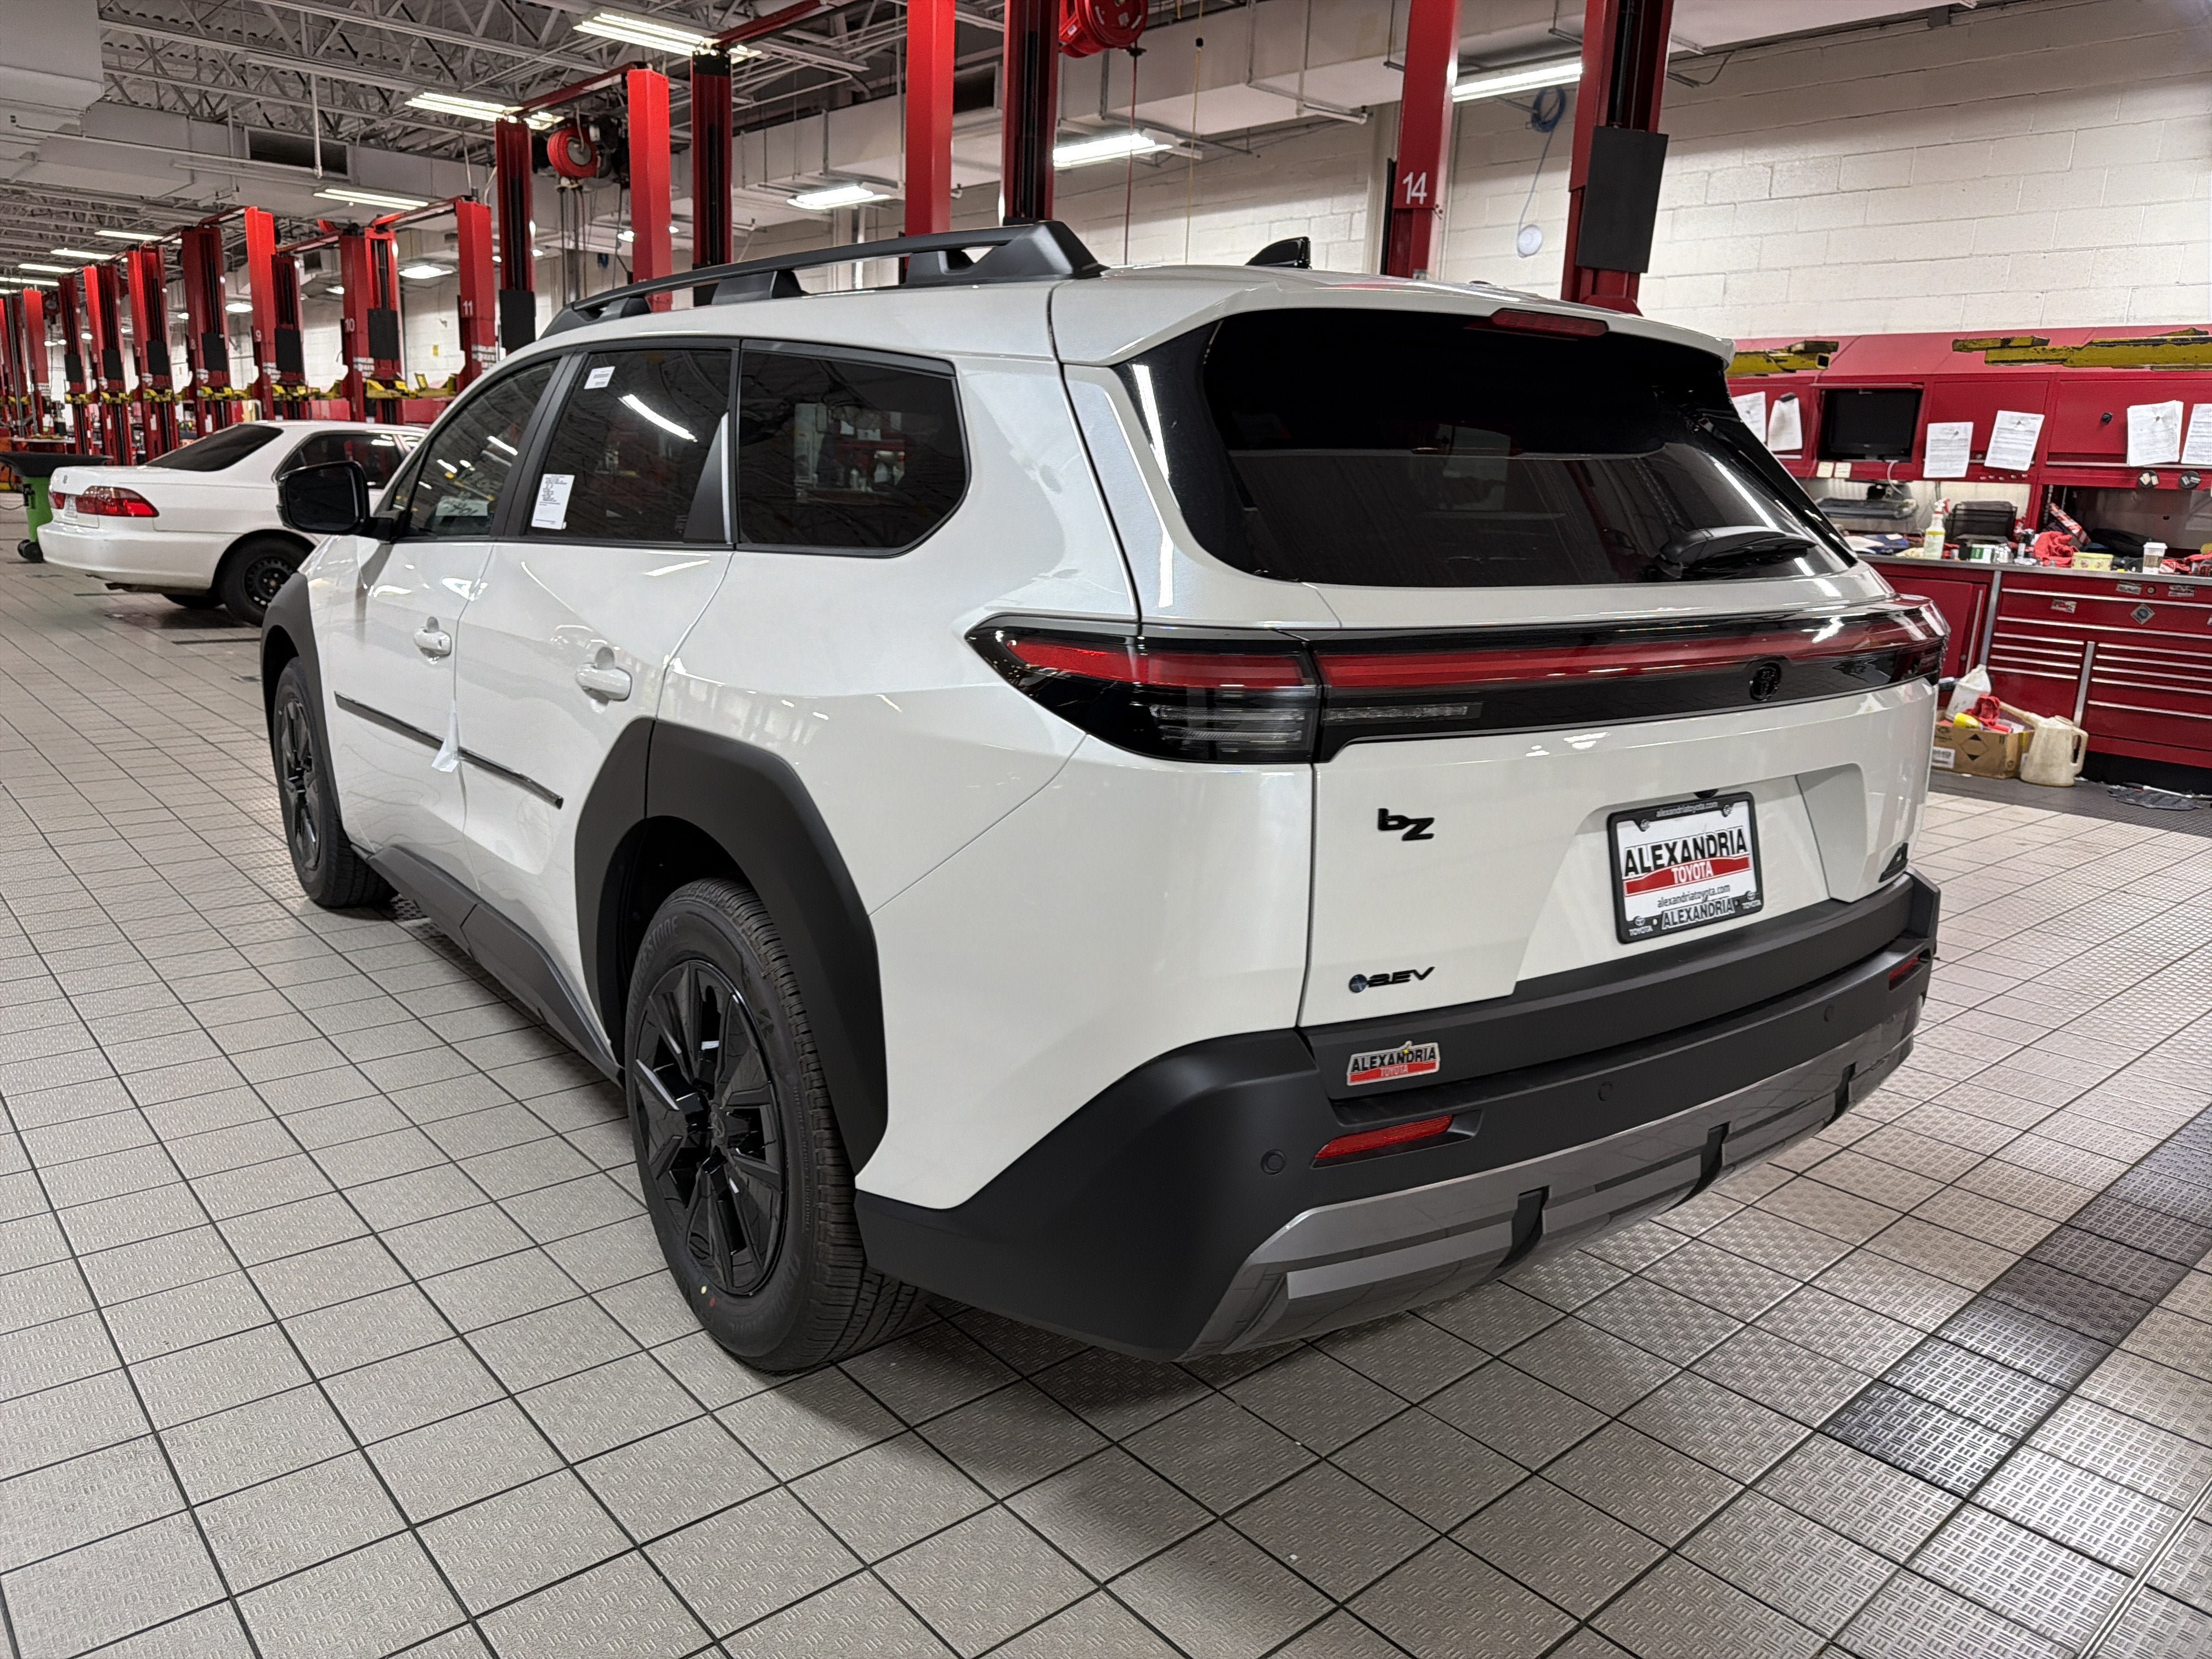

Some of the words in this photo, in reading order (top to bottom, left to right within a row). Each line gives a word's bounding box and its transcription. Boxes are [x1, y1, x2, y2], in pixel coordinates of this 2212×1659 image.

[1402, 171, 1427, 205] 14
[462, 300, 473, 317] 11
[345, 318, 356, 332] 10
[256, 329, 262, 342] 9
[136, 347, 141, 357] 7
[1624, 828, 1747, 877] ALEXANDRIA
[1671, 860, 1714, 884] TOYOTA
[1662, 898, 1735, 930] ALEXANDRIA
[1628, 925, 1654, 936] TOYOTA
[1368, 966, 1435, 988] BEV
[1351, 1047, 1437, 1073] ALEXANDRIA
[1380, 1064, 1408, 1077] TOYOTA
